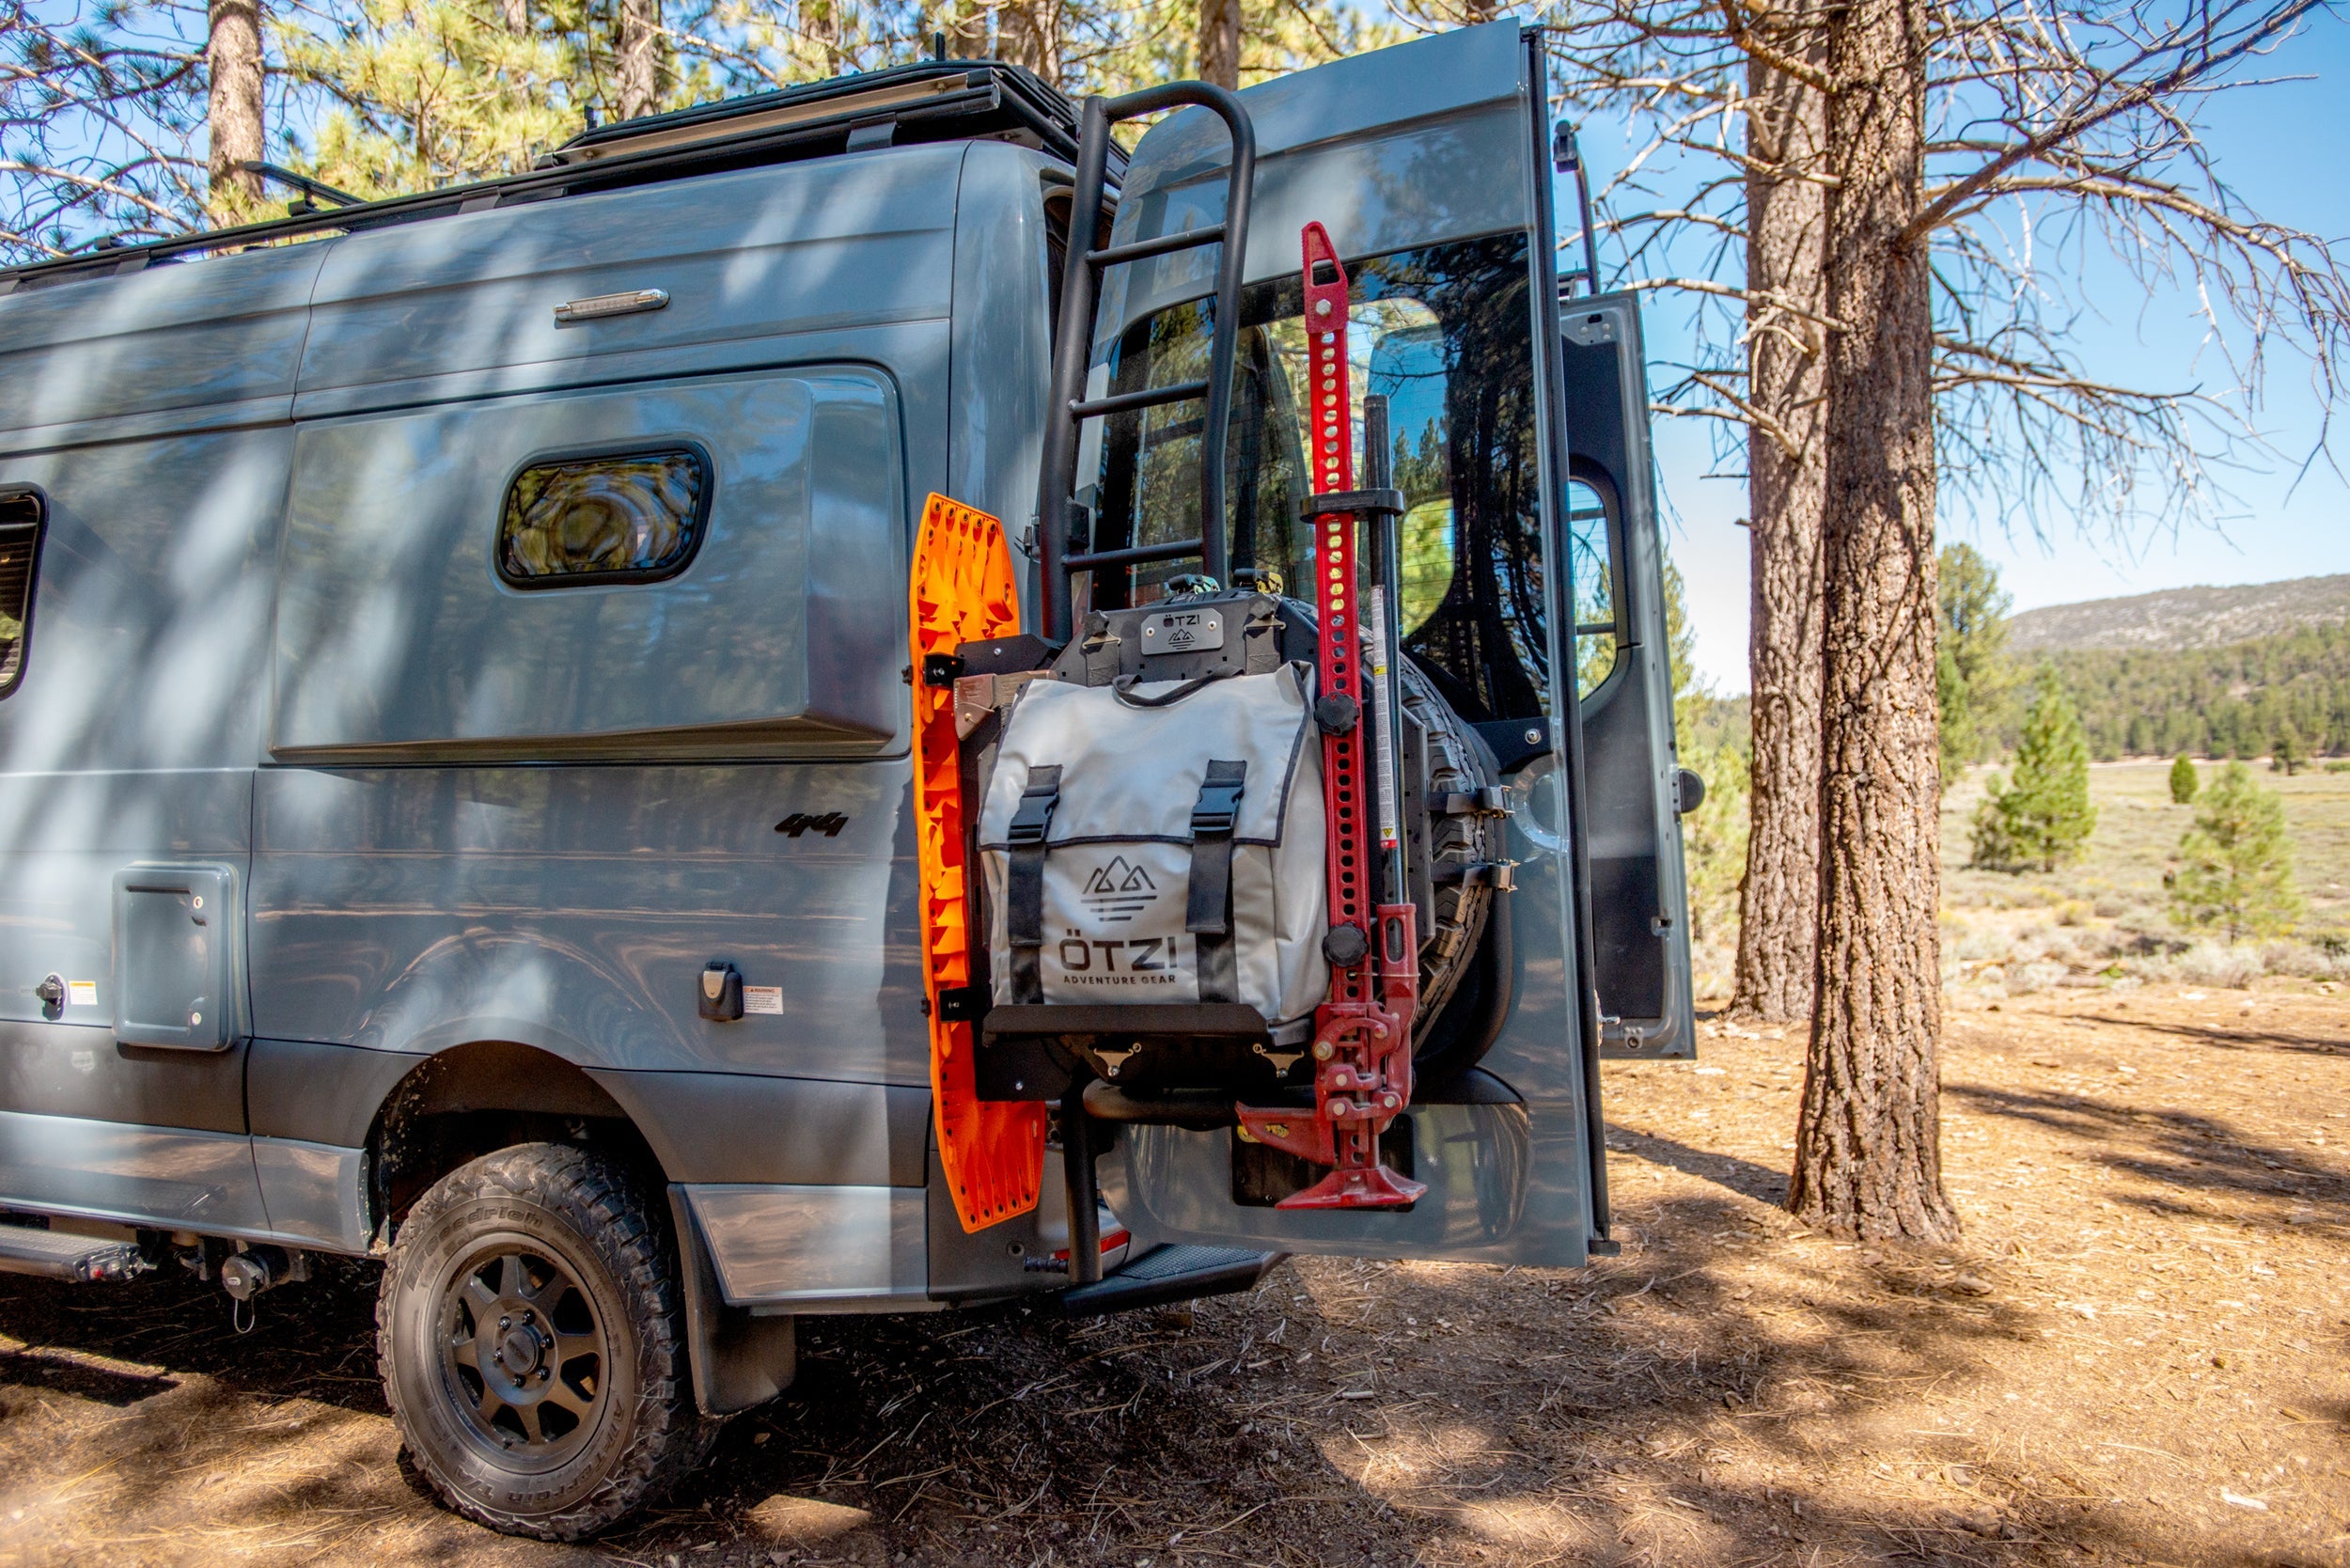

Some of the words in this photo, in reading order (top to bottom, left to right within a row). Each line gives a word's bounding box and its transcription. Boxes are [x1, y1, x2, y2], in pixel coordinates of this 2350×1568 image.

[1163, 614, 1200, 627] ÖTZI
[1058, 929, 1178, 972] ÖTZI
[1063, 975, 1136, 985] ADVENTURE
[1141, 974, 1176, 984] GEAR
